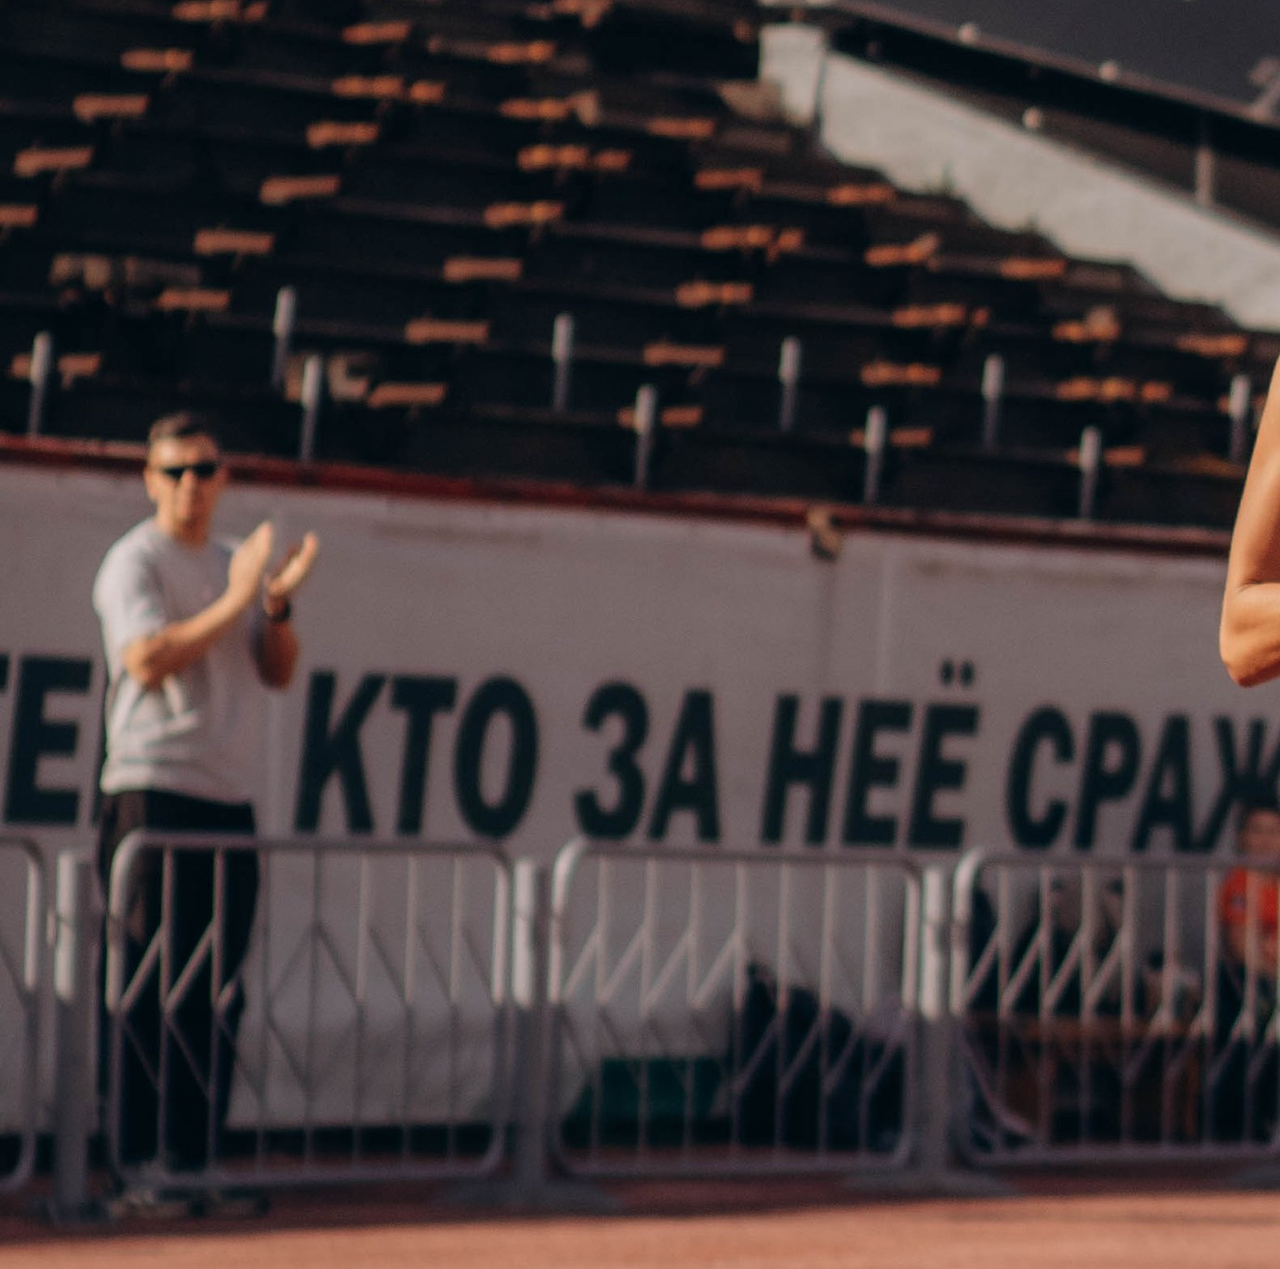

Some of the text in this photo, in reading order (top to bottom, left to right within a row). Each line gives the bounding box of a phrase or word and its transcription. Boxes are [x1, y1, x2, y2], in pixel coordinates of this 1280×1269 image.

[294, 668, 538, 838] КТО
[573, 680, 721, 843] ЗА
[761, 660, 980, 849] НЕЁ
